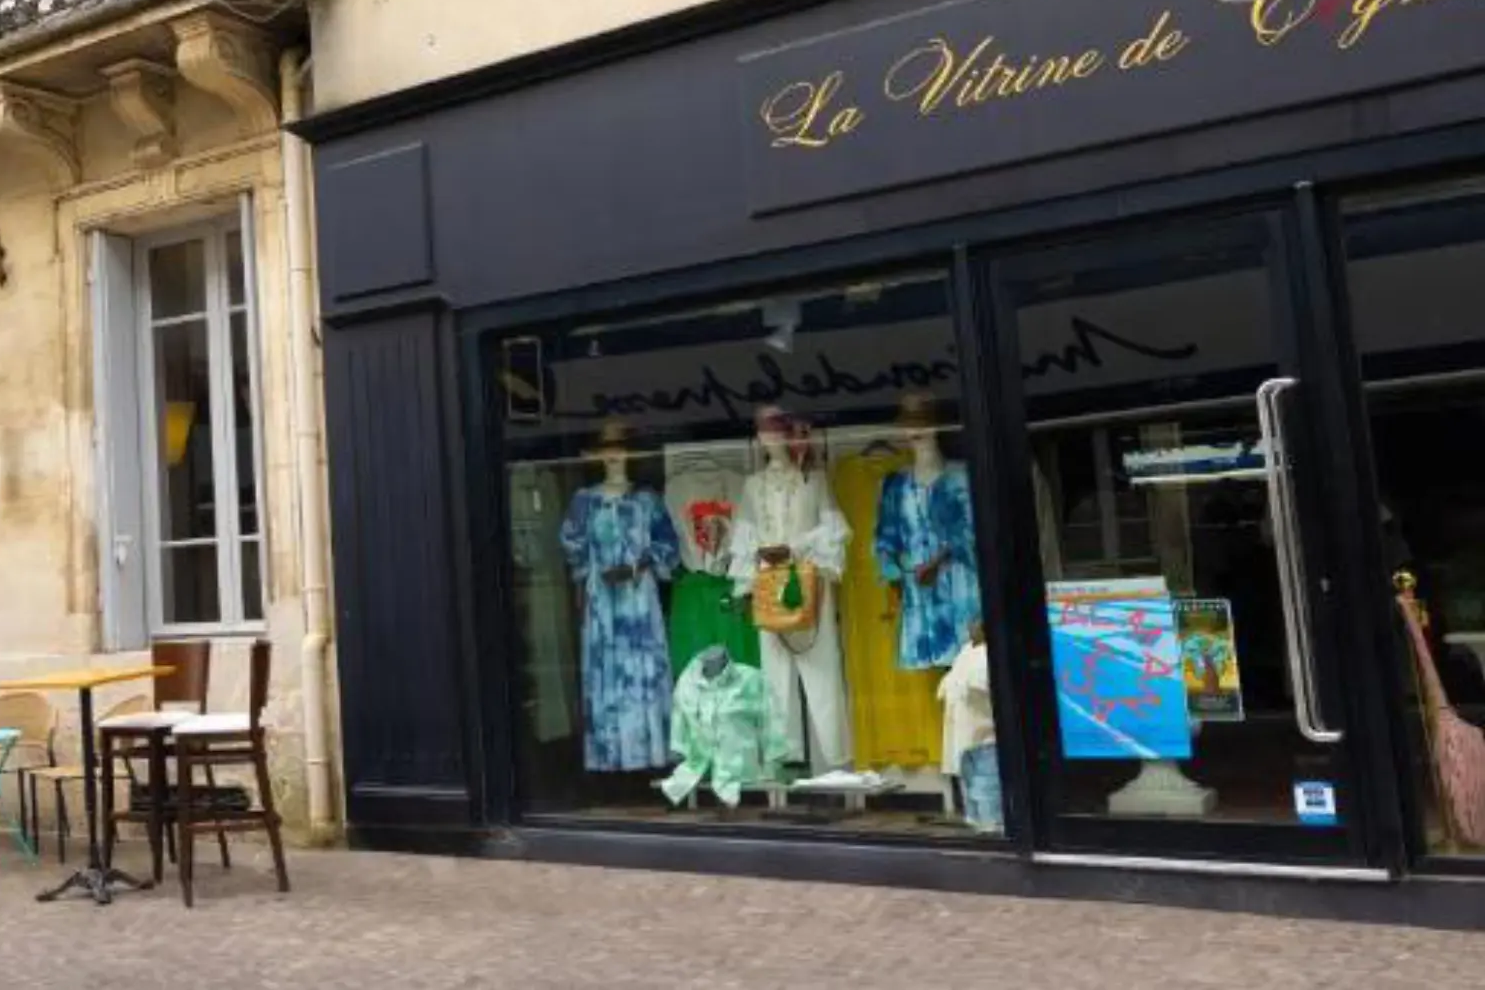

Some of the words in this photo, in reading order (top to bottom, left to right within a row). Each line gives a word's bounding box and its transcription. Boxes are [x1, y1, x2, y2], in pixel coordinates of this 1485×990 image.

[762, 70, 865, 148] La
[884, 36, 1106, 115] Vitrine
[1118, 10, 1191, 70] de
